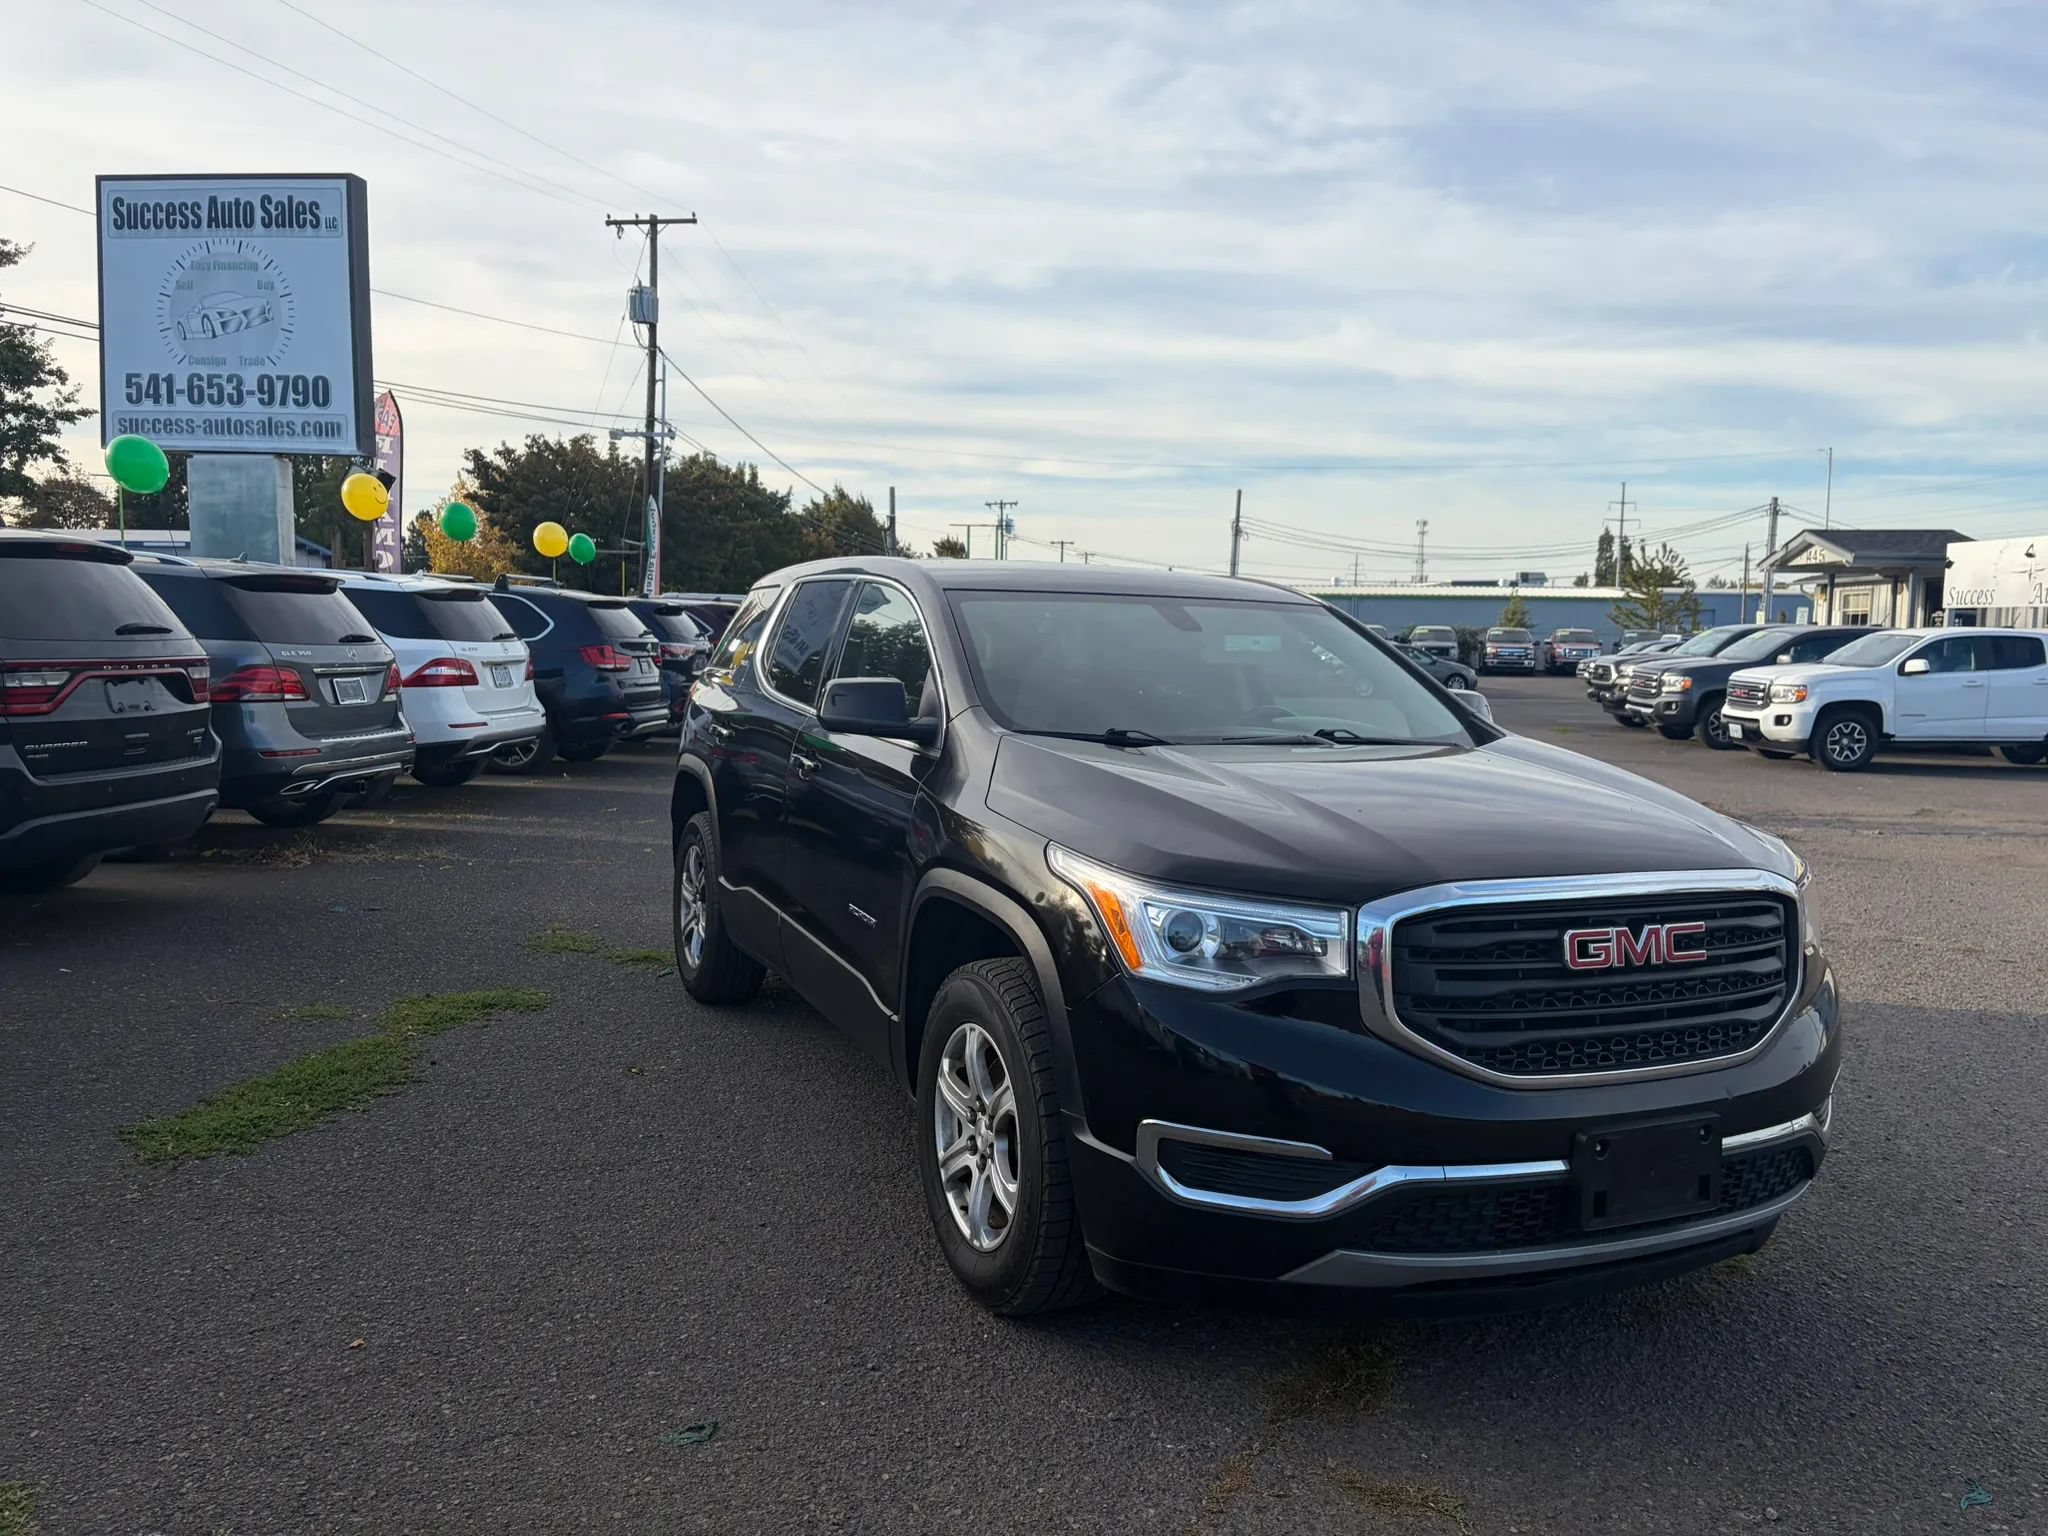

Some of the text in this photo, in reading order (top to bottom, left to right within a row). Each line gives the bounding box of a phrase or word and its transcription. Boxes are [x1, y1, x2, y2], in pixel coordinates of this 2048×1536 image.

[112, 194, 338, 231] Success Auto Sales LLC
[212, 260, 259, 272] Financing
[175, 279, 194, 290] Sell
[256, 279, 275, 291] Buy
[188, 354, 227, 367] Consign
[239, 355, 266, 366] Trade
[125, 372, 331, 409] 541-653-9790
[117, 416, 342, 439] success-autosales.com
[1946, 582, 2048, 607] Success A
[1563, 921, 1707, 970] GMC
